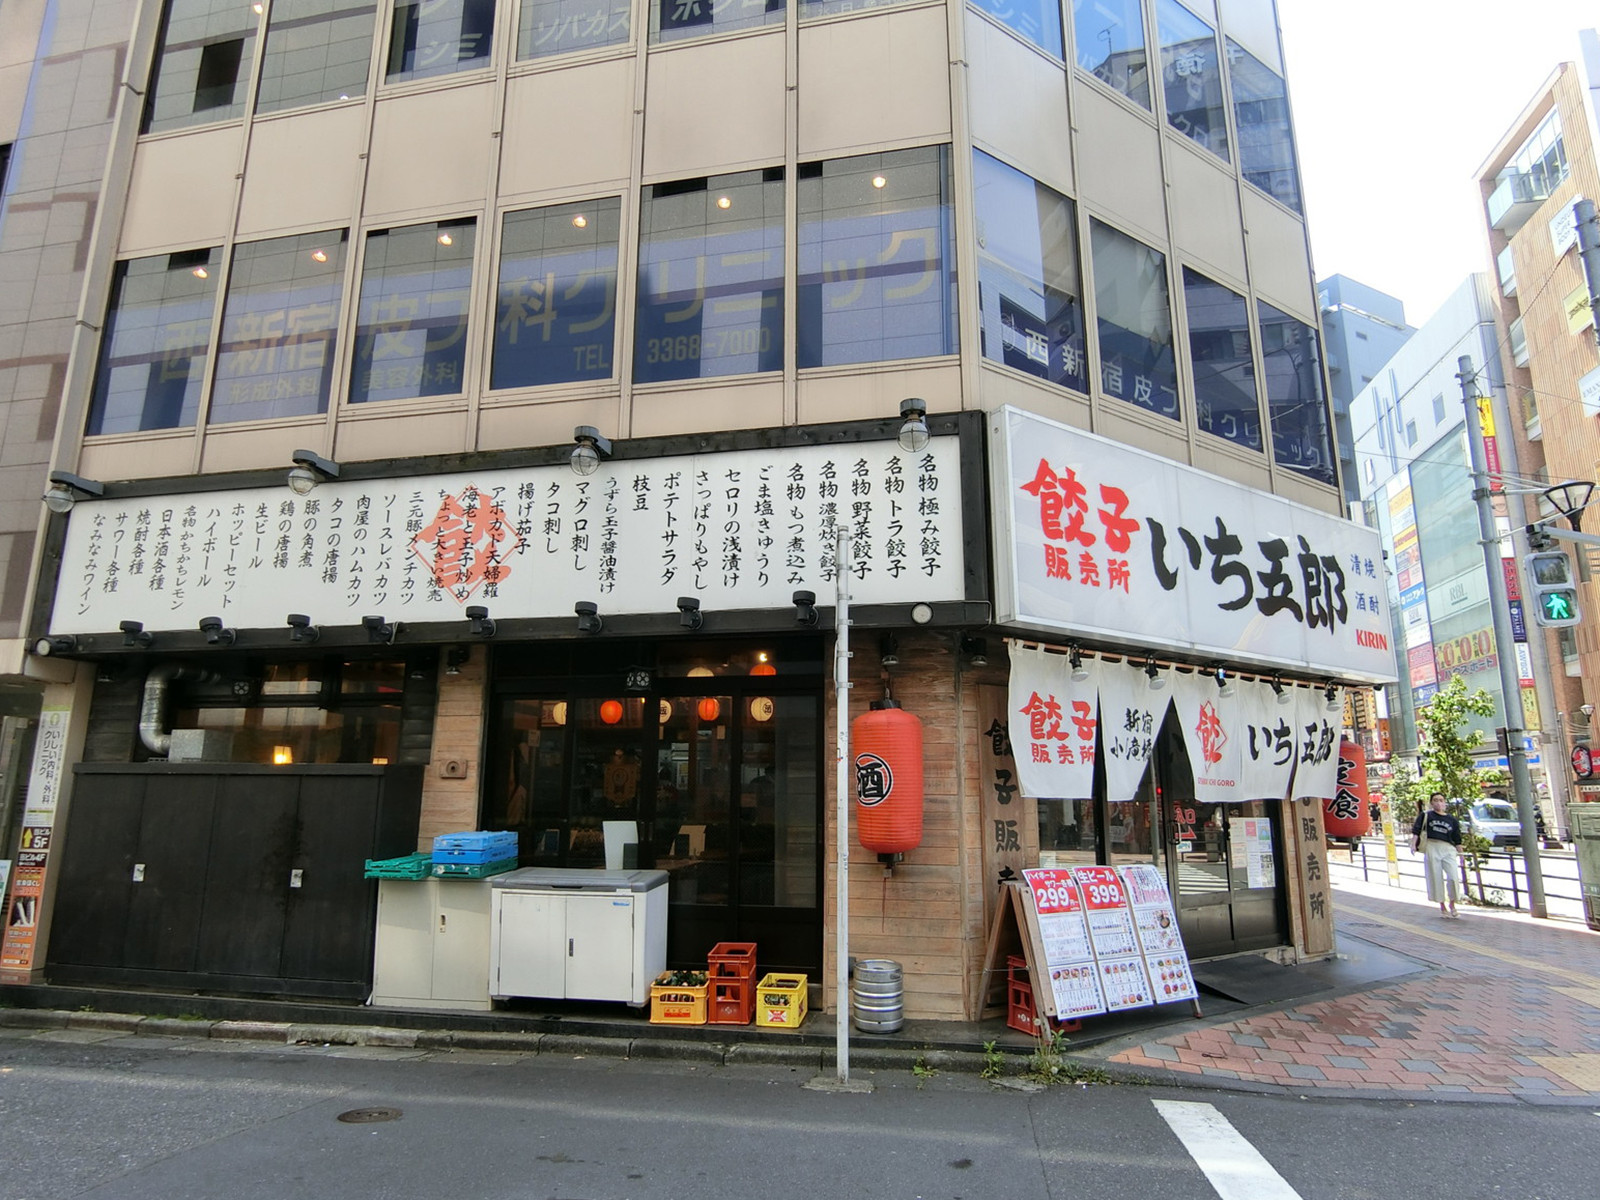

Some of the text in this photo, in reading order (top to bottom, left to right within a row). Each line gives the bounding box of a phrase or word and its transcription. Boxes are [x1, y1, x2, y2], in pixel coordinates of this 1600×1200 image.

[534, 9, 631, 47] ソバカス
[573, 326, 771, 371] TEL 3368-7000
[514, 482, 535, 555] 揚げ茄子
[543, 482, 561, 554] タコ刺し
[572, 481, 591, 571] マグロ刺し
[632, 475, 651, 511] 枝豆
[1019, 458, 1140, 553] 餃子
[103, 512, 128, 593] サワー各種
[128, 509, 152, 575] 焼酎各種
[149, 509, 174, 591] 日本酒各種
[197, 509, 221, 587] ハイボール
[222, 503, 245, 609] ホッピーセット
[248, 502, 269, 569] 生ビール
[273, 500, 295, 569] 鶏の唐揚
[298, 499, 320, 568] 豚の角煮
[322, 497, 343, 584] タコの唐揚
[347, 494, 371, 607] 肉屋のハムカツ
[374, 494, 396, 606] ソースレバカツ
[401, 491, 424, 606] 三元豚メンチカツ
[599, 477, 621, 594] うずら玉子醤油漬け
[661, 471, 682, 586] ポテトサラダ
[692, 470, 712, 590] さっぱりもやし
[722, 468, 742, 589] セロリの浅漬け
[78, 513, 107, 615] なみなみワイン
[1043, 543, 1130, 594] 販売所
[1146, 516, 1348, 635] いち五郎
[1350, 553, 1366, 612] 清酒
[1364, 558, 1380, 616] 焼酎
[1356, 629, 1388, 650] KIRIN
[1019, 691, 1097, 741] 餃子
[1123, 707, 1154, 735] 新宿
[1247, 717, 1335, 767] いち五郎
[39, 730, 52, 776] クリニック
[856, 762, 885, 800] 酒
[1030, 742, 1096, 765] 販売所
[1217, 779, 1235, 787] GORO
[1327, 756, 1360, 820] 定食
[34, 836, 49, 848] 5F
[1037, 887, 1070, 908] 299
[1078, 870, 1114, 884] 生ビール
[1089, 884, 1119, 904] 399
